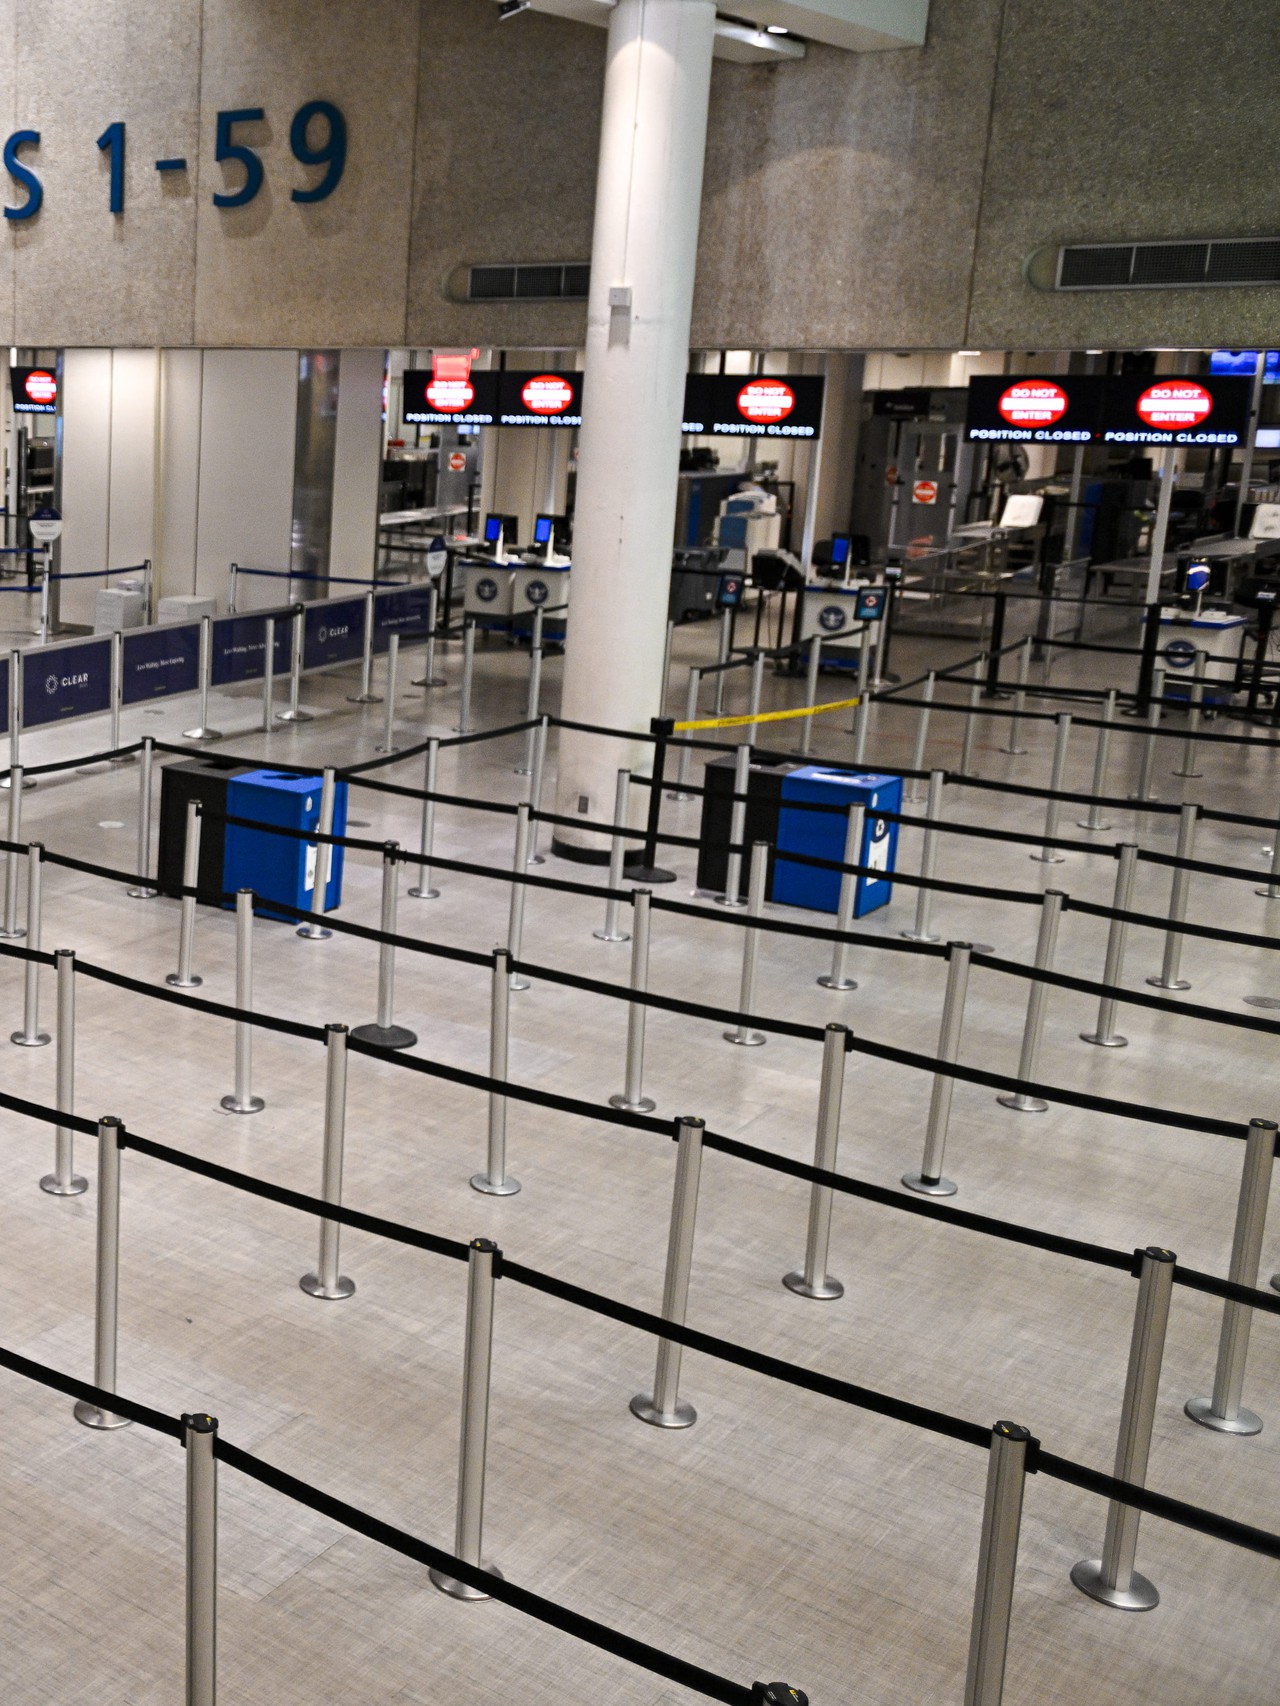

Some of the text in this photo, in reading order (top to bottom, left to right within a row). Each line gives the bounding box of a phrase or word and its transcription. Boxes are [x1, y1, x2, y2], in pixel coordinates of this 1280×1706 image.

[747, 386, 786, 396] DO NOT
[1011, 388, 1057, 398] DO NOT
[1150, 389, 1202, 399] DO NOT
[15, 403, 45, 411] POSITION
[747, 407, 782, 417] ENTER
[406, 413, 493, 423] POSITION CLOSED
[501, 415, 581, 424] POSITION CLOS
[1011, 411, 1052, 420] ENTER
[1151, 412, 1195, 422] ENTER
[681, 422, 704, 433] SED
[713, 423, 815, 436] POSITION CLOSED
[970, 429, 1091, 440] POSITION CLOSED
[1104, 431, 1238, 443] POSITION CLOSED
[329, 625, 349, 637] CLEAR
[62, 672, 89, 687] CLEAR
